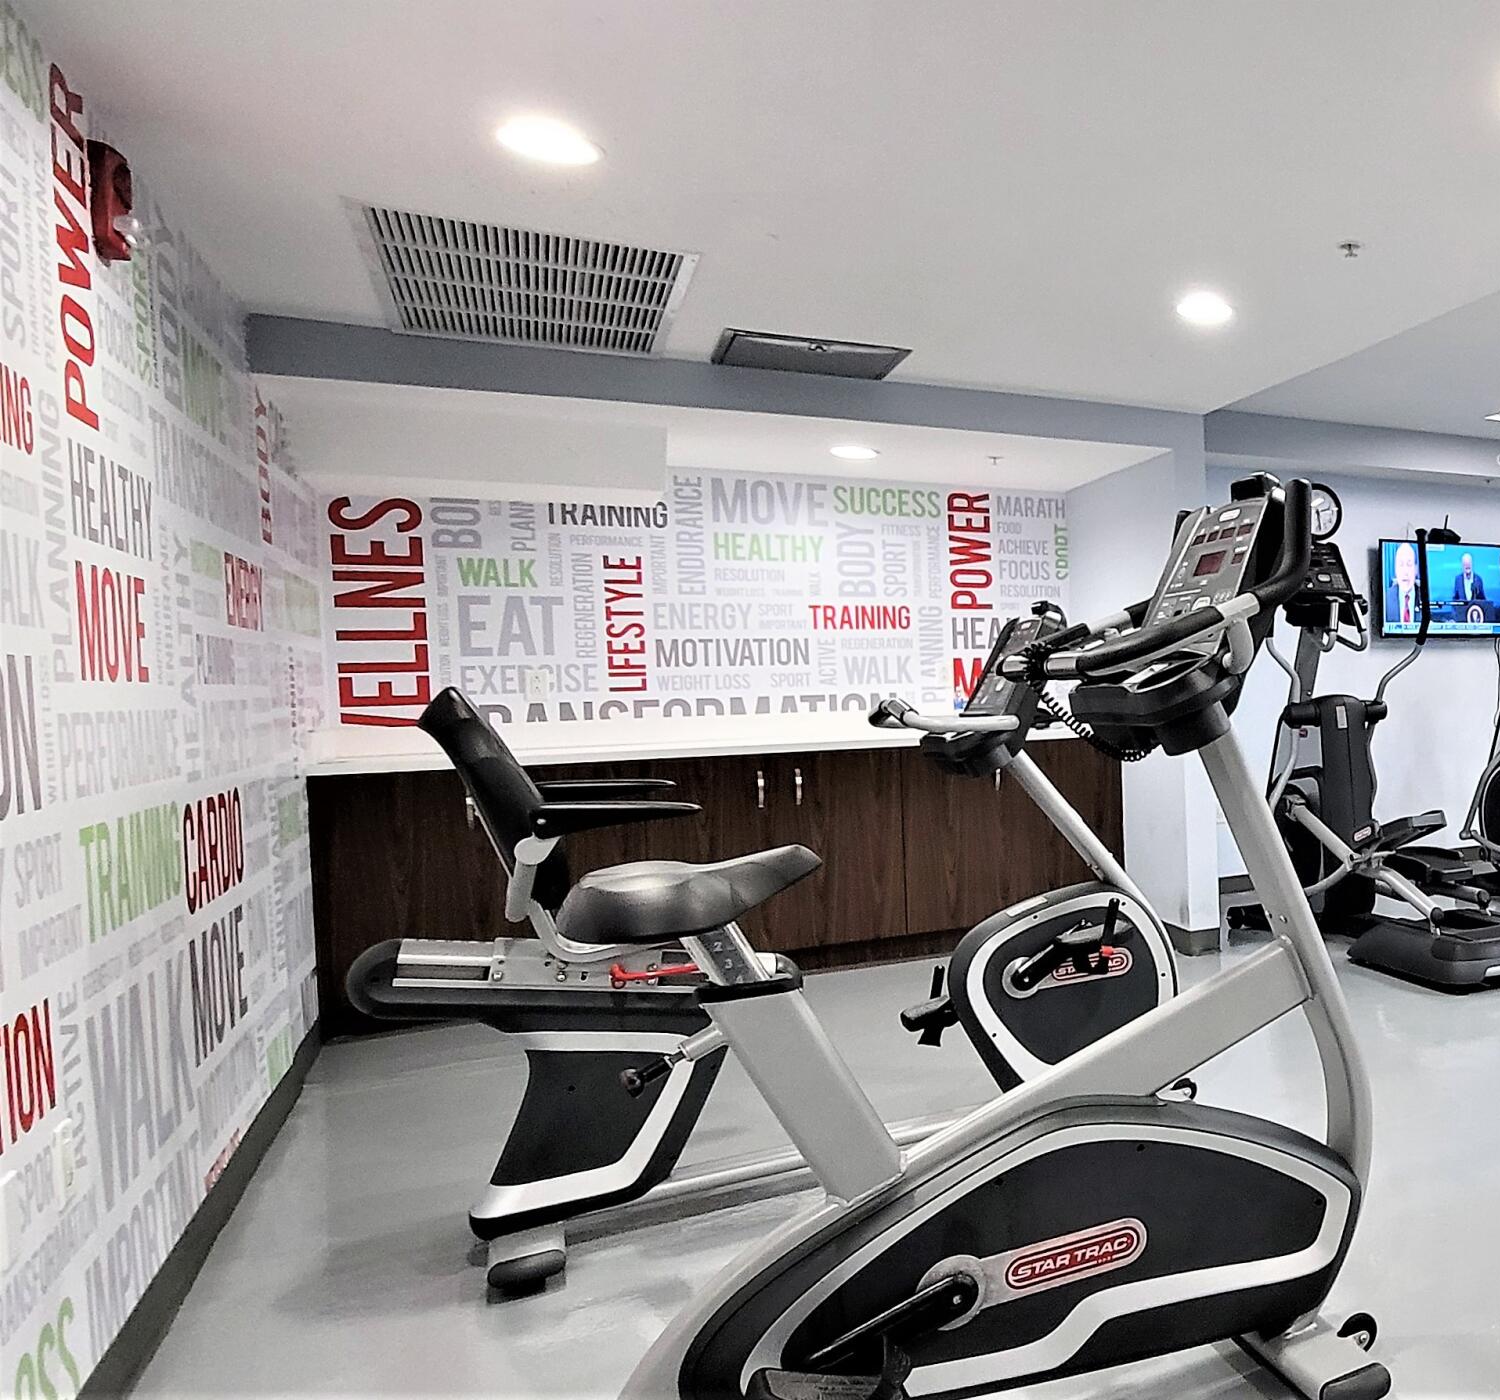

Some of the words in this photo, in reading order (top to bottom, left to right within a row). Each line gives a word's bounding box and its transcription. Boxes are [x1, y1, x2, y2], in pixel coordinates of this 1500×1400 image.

[48, 61, 100, 431] POWER
[254, 384, 273, 545] BODY
[68, 437, 152, 561] HEALTHY
[547, 499, 669, 529] TRAINING
[710, 477, 829, 527] MOVE
[832, 485, 942, 518] SUCCESS
[39, 388, 75, 682] PLANNING
[569, 533, 644, 548] PERFORMANCE
[672, 474, 706, 596] ENDURANCE
[712, 531, 824, 563] HEALTHY
[881, 523, 921, 538] FITNESS
[947, 491, 994, 611] POWER
[996, 521, 1022, 535] FOOD
[998, 539, 1049, 556] ACHIEVE
[456, 556, 538, 588] WALK
[714, 567, 785, 583] RESOLUTION
[835, 520, 877, 598] BODY
[882, 538, 908, 598] SPORT
[926, 523, 942, 600] PERFORMANCE
[999, 559, 1050, 580] FOCUS
[224, 551, 264, 632] ENERGY
[570, 552, 598, 659] REGENERATION
[758, 603, 793, 617] SPORT
[999, 584, 1061, 598] RESOLUTION
[74, 559, 150, 683] MOVE
[456, 594, 565, 657] EAT
[601, 553, 648, 693] LIFESTYLE
[652, 602, 753, 630] ENERGY
[807, 604, 911, 631] TRAINING
[171, 531, 202, 784] HEALTHY
[655, 638, 810, 668] MOTIVATION
[817, 639, 837, 687] ACTIVE
[840, 637, 914, 650] REGENERATION
[917, 604, 945, 703] PLANNING
[655, 674, 712, 691] WEIGHT
[714, 673, 751, 690] LOSS
[770, 671, 812, 688] SPORT
[842, 655, 914, 685] WALK
[13, 832, 63, 909] SPORT
[79, 800, 182, 943] TRAINING
[183, 785, 244, 915] CARDIO
[188, 903, 248, 1069] MOVE
[724, 958, 733, 969] 3
[84, 949, 195, 1212] WALK
[1017, 1253, 1070, 1280] STAR
[1074, 1237, 1128, 1261] TRAC
